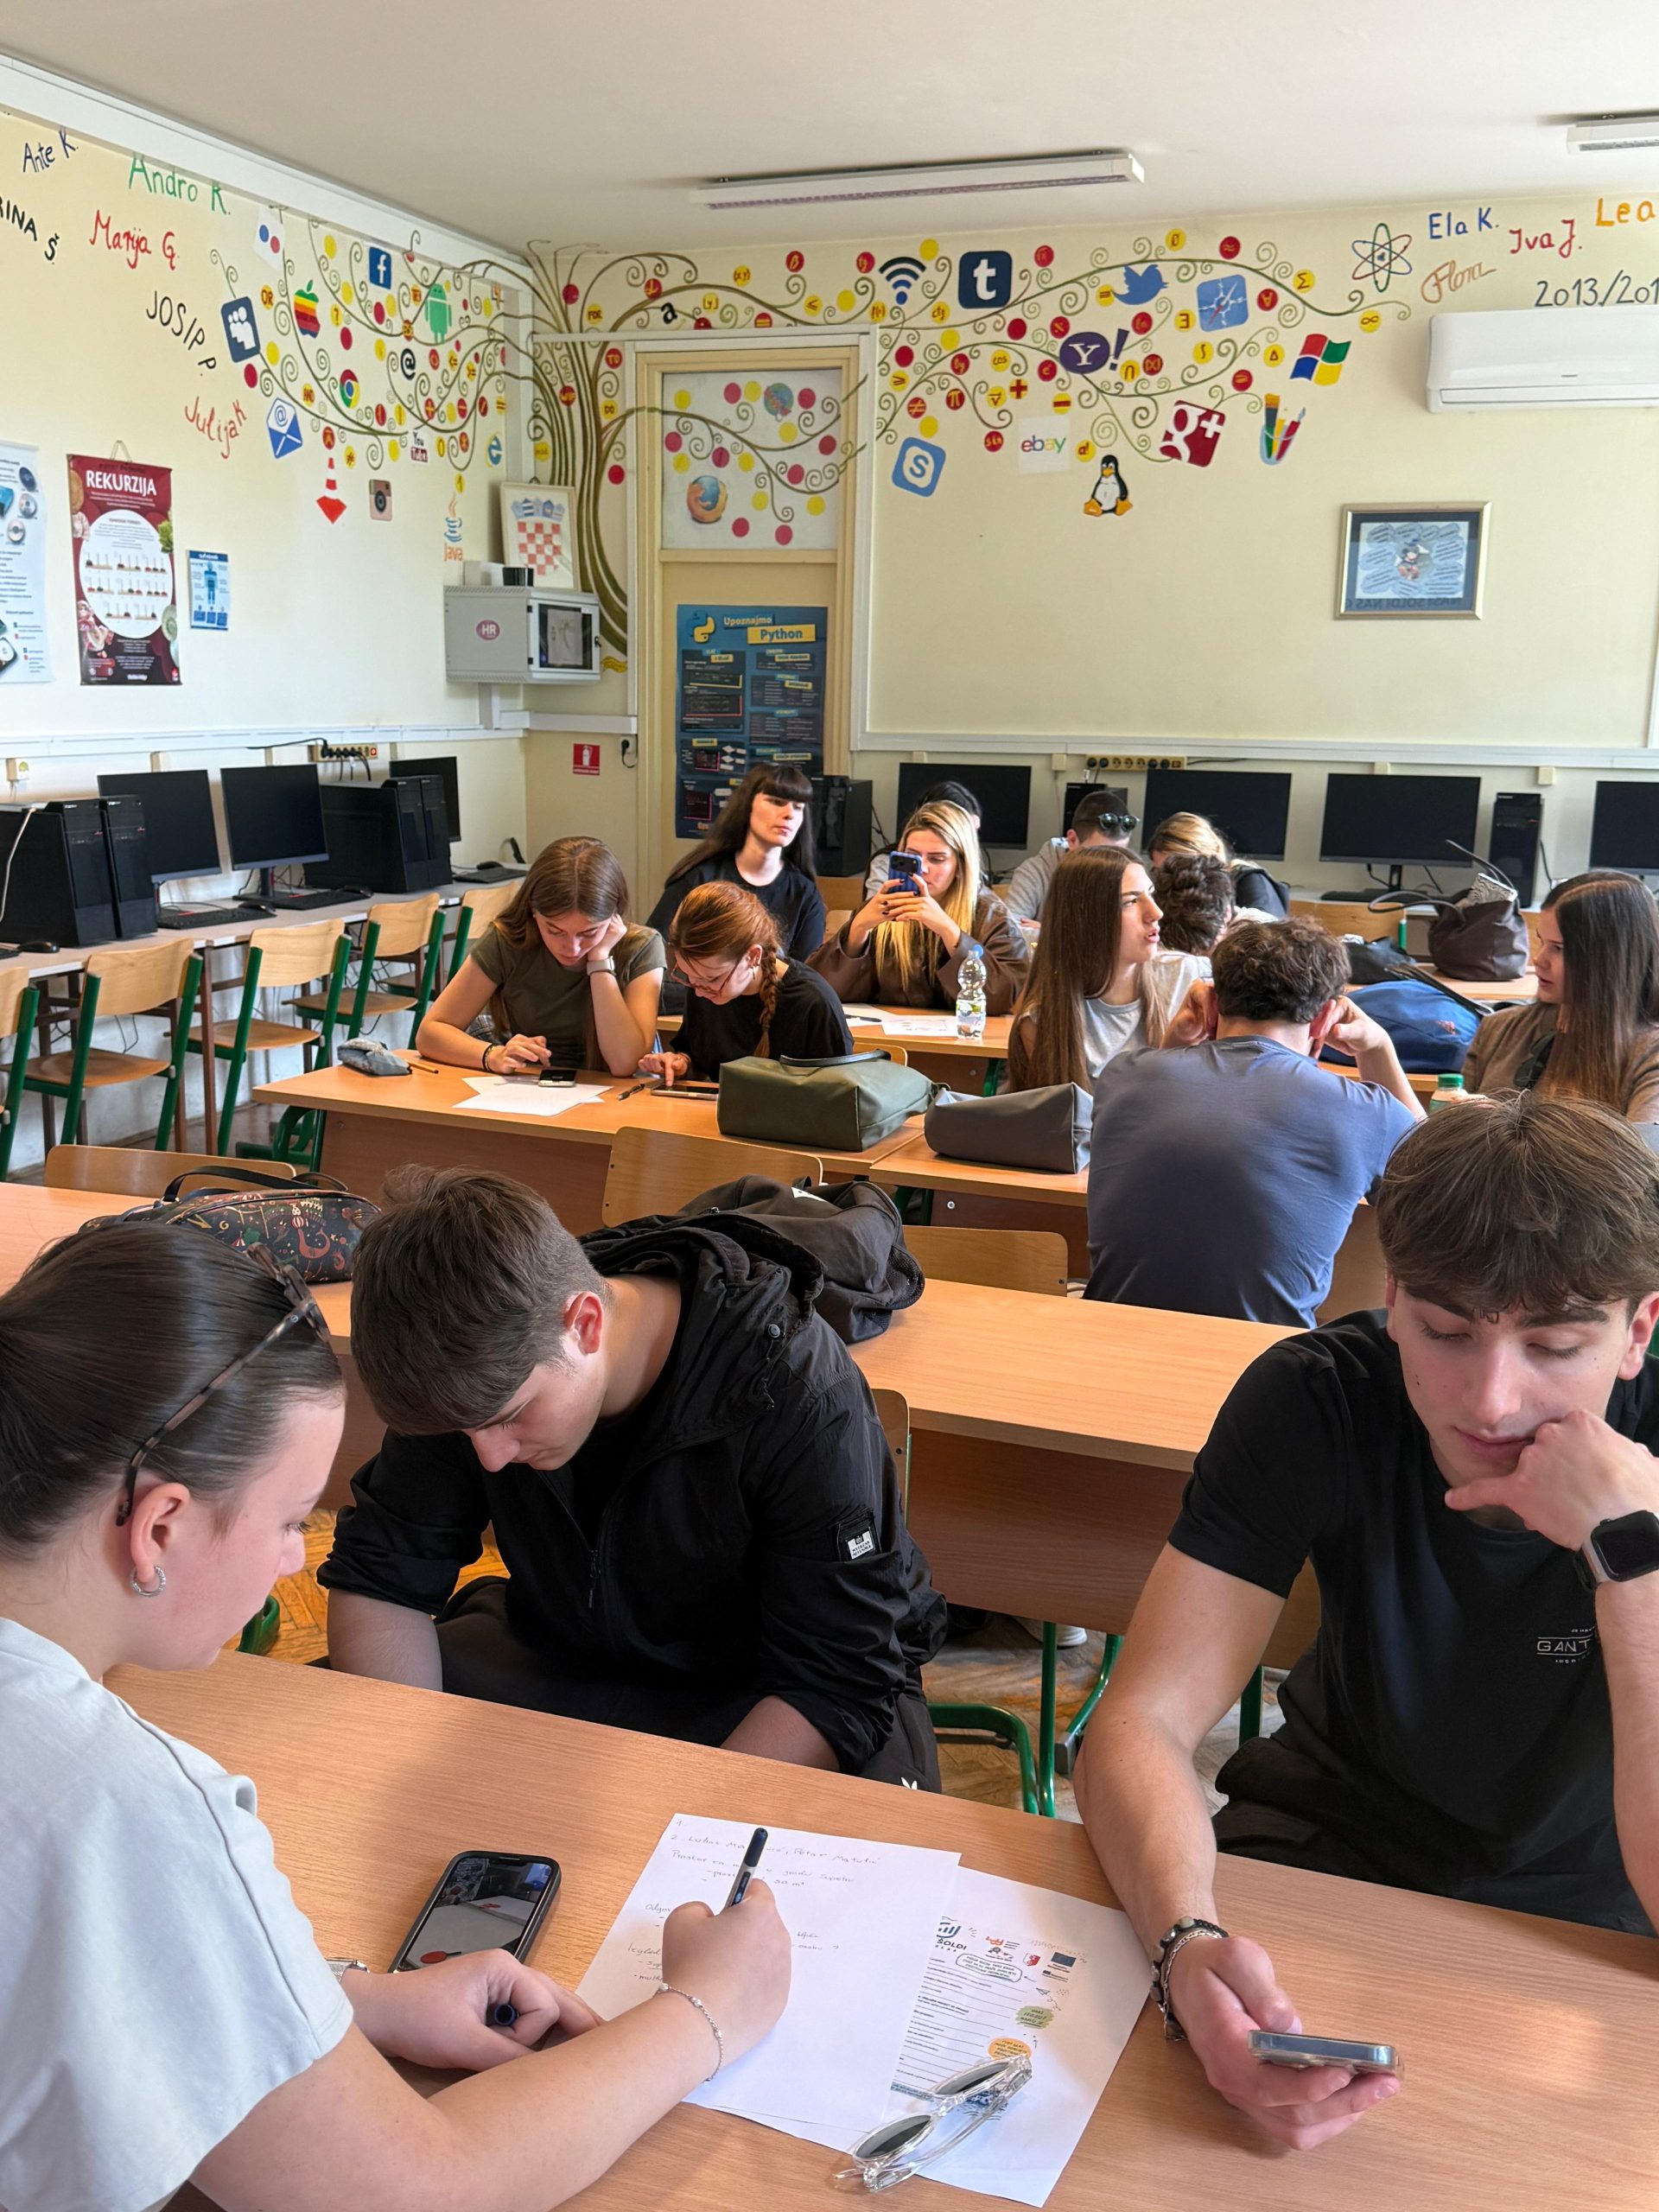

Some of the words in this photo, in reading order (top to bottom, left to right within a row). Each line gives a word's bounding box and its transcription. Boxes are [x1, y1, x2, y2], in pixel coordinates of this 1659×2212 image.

[23, 143, 55, 173] Ante
[129, 153, 198, 201] Andro
[1429, 212, 1468, 239] Ela
[1478, 207, 1499, 232] K.
[1595, 198, 1656, 226] Lea
[89, 209, 152, 270] Marija
[973, 258, 996, 302] t
[146, 290, 206, 351] JOSIP
[1020, 435, 1067, 454] ebay
[909, 454, 930, 479] S
[86, 470, 157, 497] REKURZIJA
[481, 624, 497, 636] HR
[760, 629, 804, 642] Python
[1537, 1638, 1591, 1652] GANT
